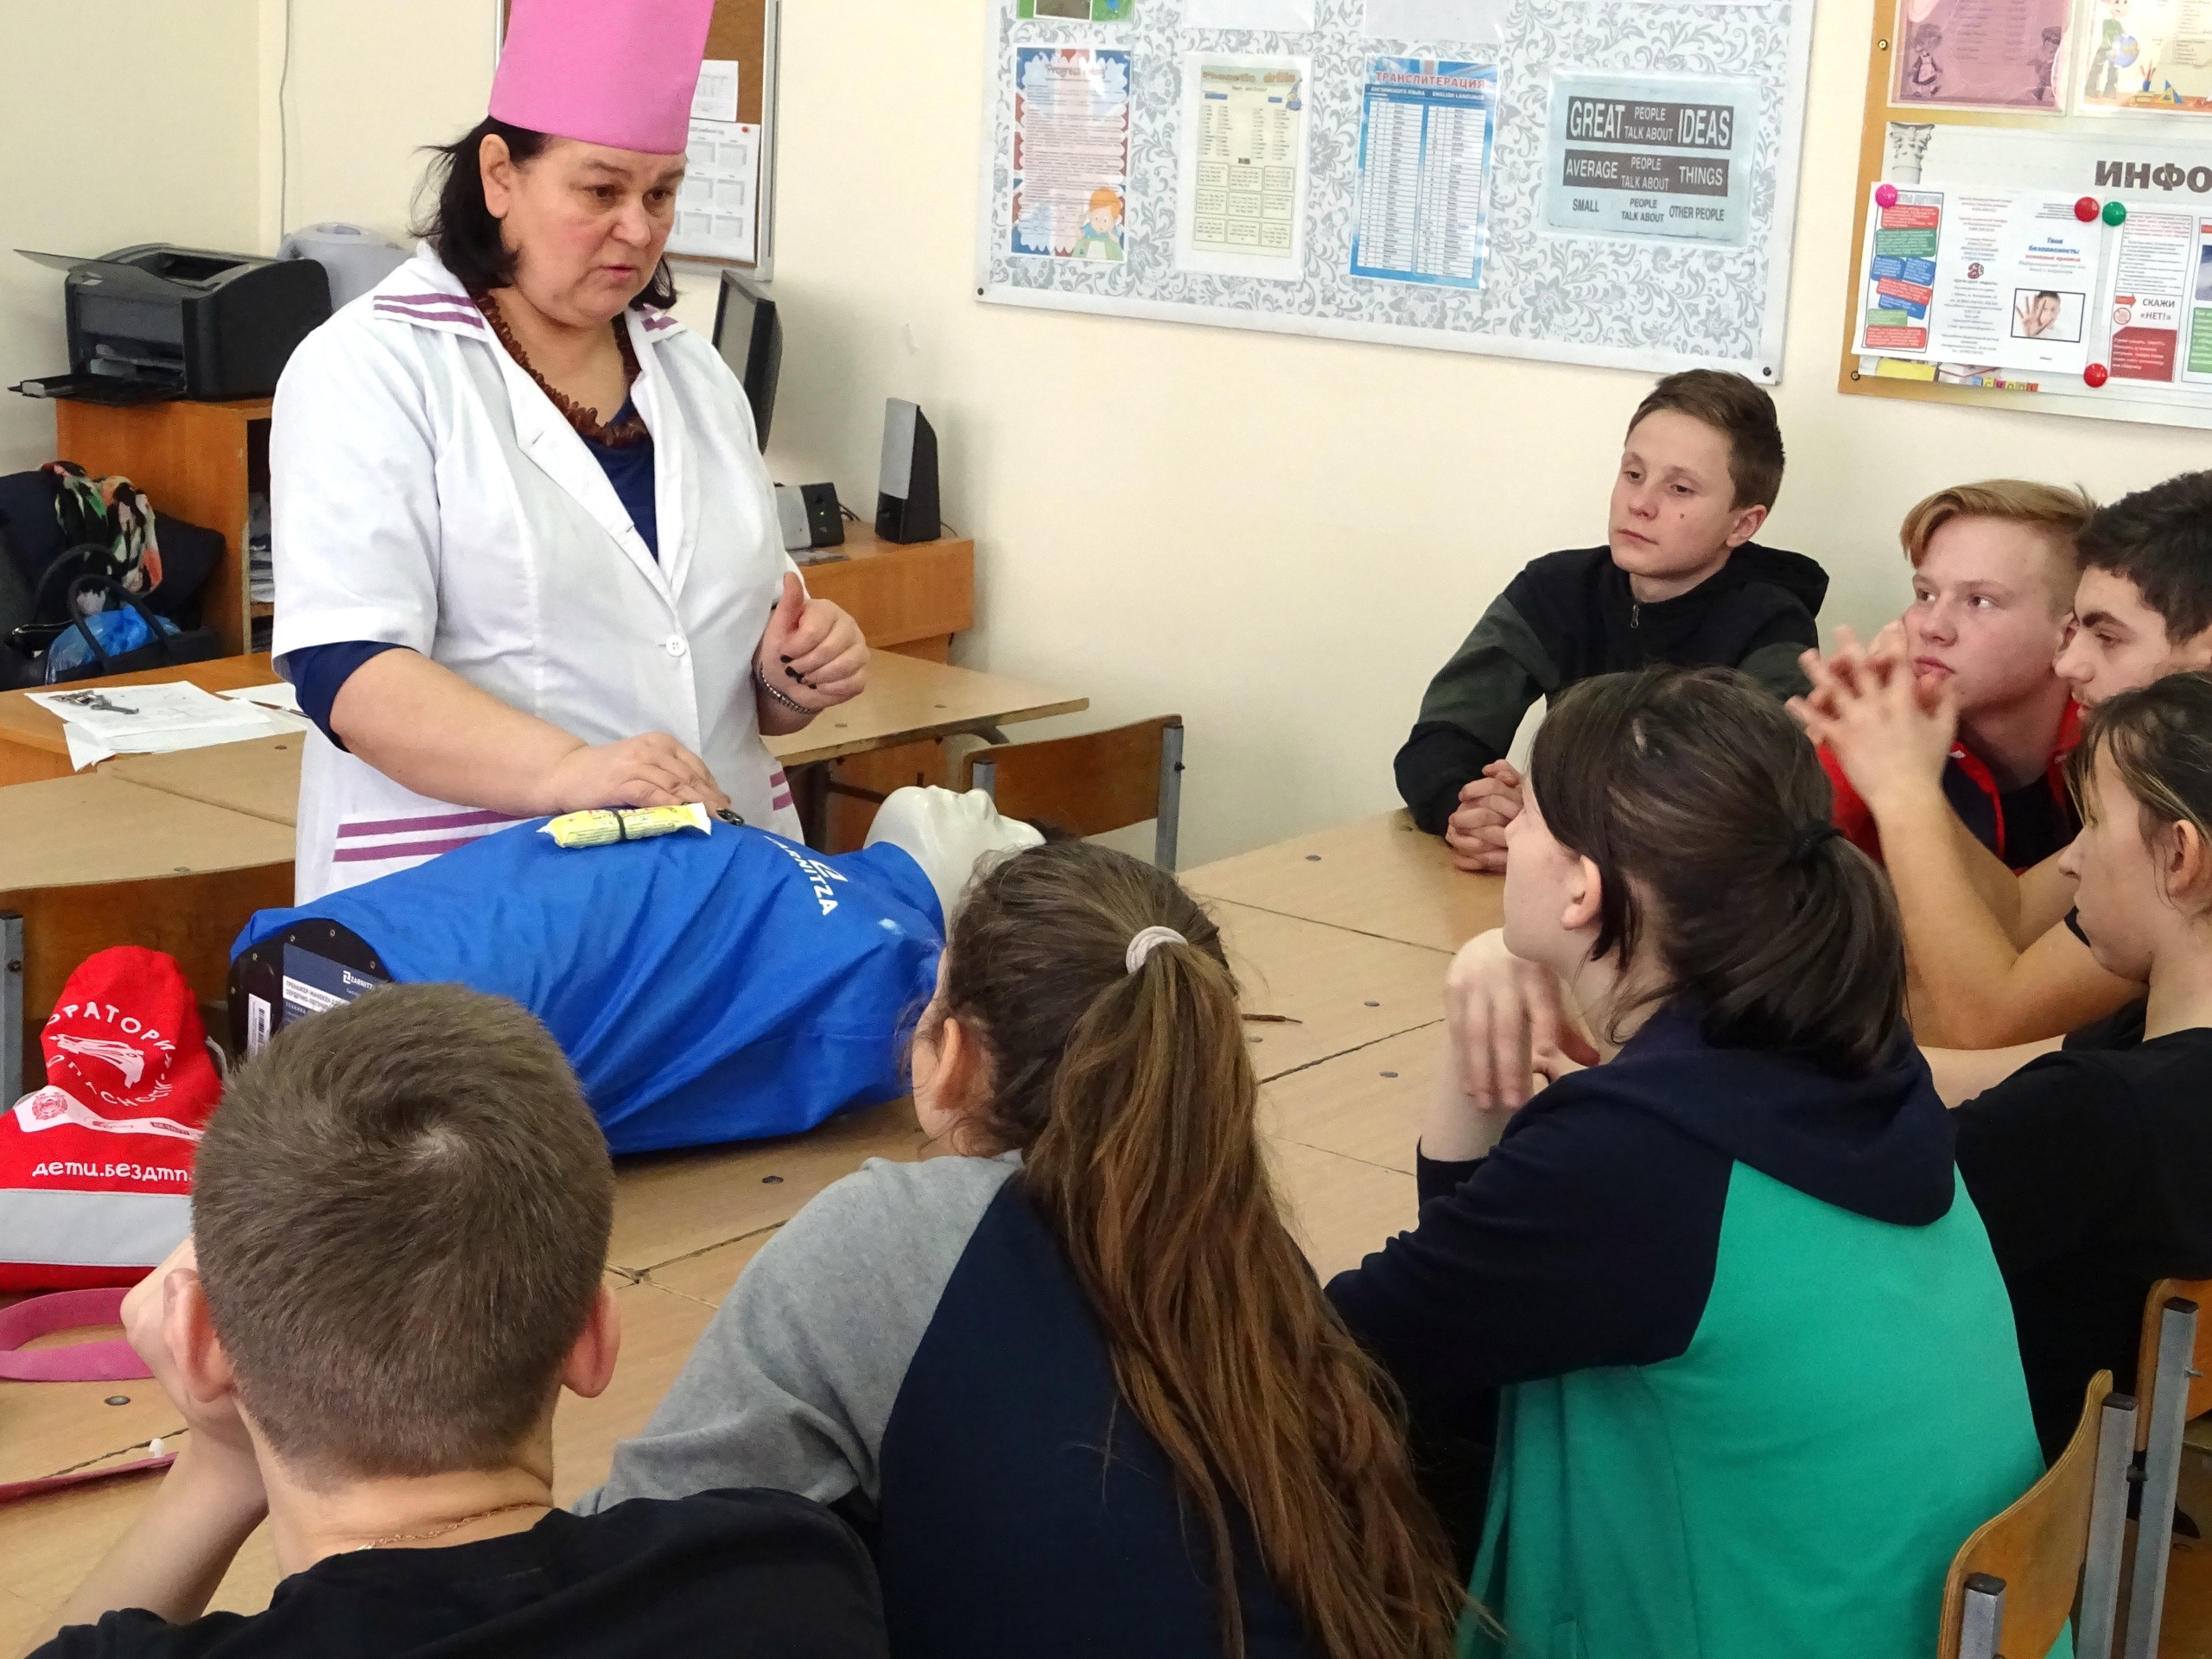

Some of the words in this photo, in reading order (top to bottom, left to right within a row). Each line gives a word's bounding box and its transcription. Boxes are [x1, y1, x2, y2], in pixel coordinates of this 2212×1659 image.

[1376, 71, 1485, 89] ТРАНСЛИТЕРАЦИЯ
[1569, 100, 1625, 139] GREAT
[1634, 106, 1666, 121] PEOPLE
[1624, 125, 1643, 140] TALK
[1645, 127, 1674, 142] ABOUT
[1677, 108, 1731, 147] IDEAS
[1566, 158, 1618, 179] AVERAGE
[1630, 156, 1662, 171] PEOPLE
[1621, 175, 1640, 189] TALK
[1642, 176, 1669, 191] ABOUT
[1679, 165, 1723, 186] THINGS
[2094, 160, 2212, 193] ИНФО
[1573, 199, 1599, 213] SMALL
[1630, 198, 1658, 209] PEOPLE
[1621, 211, 1638, 221] TALK
[1639, 212, 1664, 223] ABOUT
[1669, 205, 1694, 219] OTHER
[1695, 207, 1725, 221] PEOPLE
[2142, 298, 2176, 308] СКАЖИ
[2140, 312, 2171, 321] «НЕТ!»
